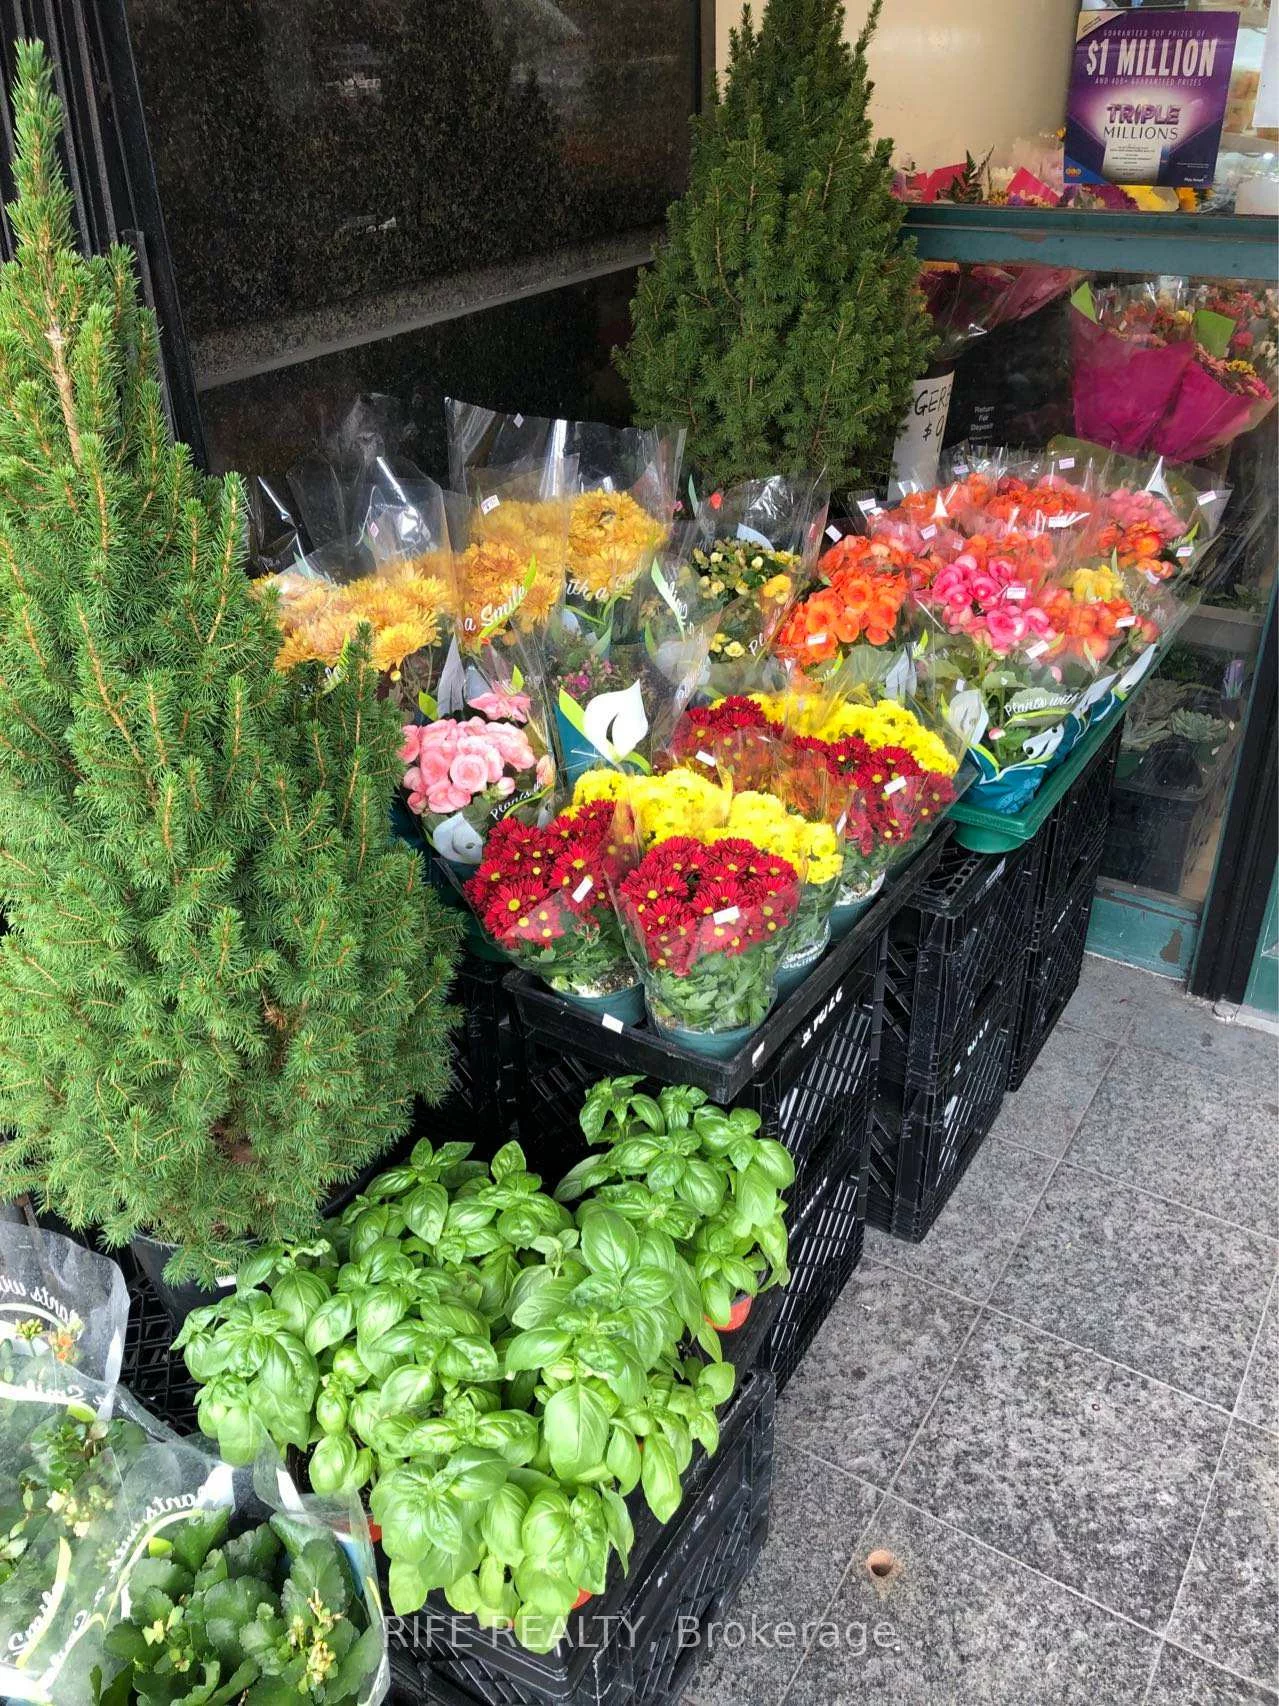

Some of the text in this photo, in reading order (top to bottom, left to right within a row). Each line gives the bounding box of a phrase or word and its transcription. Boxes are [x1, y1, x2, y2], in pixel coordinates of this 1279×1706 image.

[1086, 38, 1218, 77] $1 MILLION
[1106, 103, 1182, 125] TRIPLE
[1103, 126, 1178, 140] MILLIONS
[464, 616, 477, 632] a
